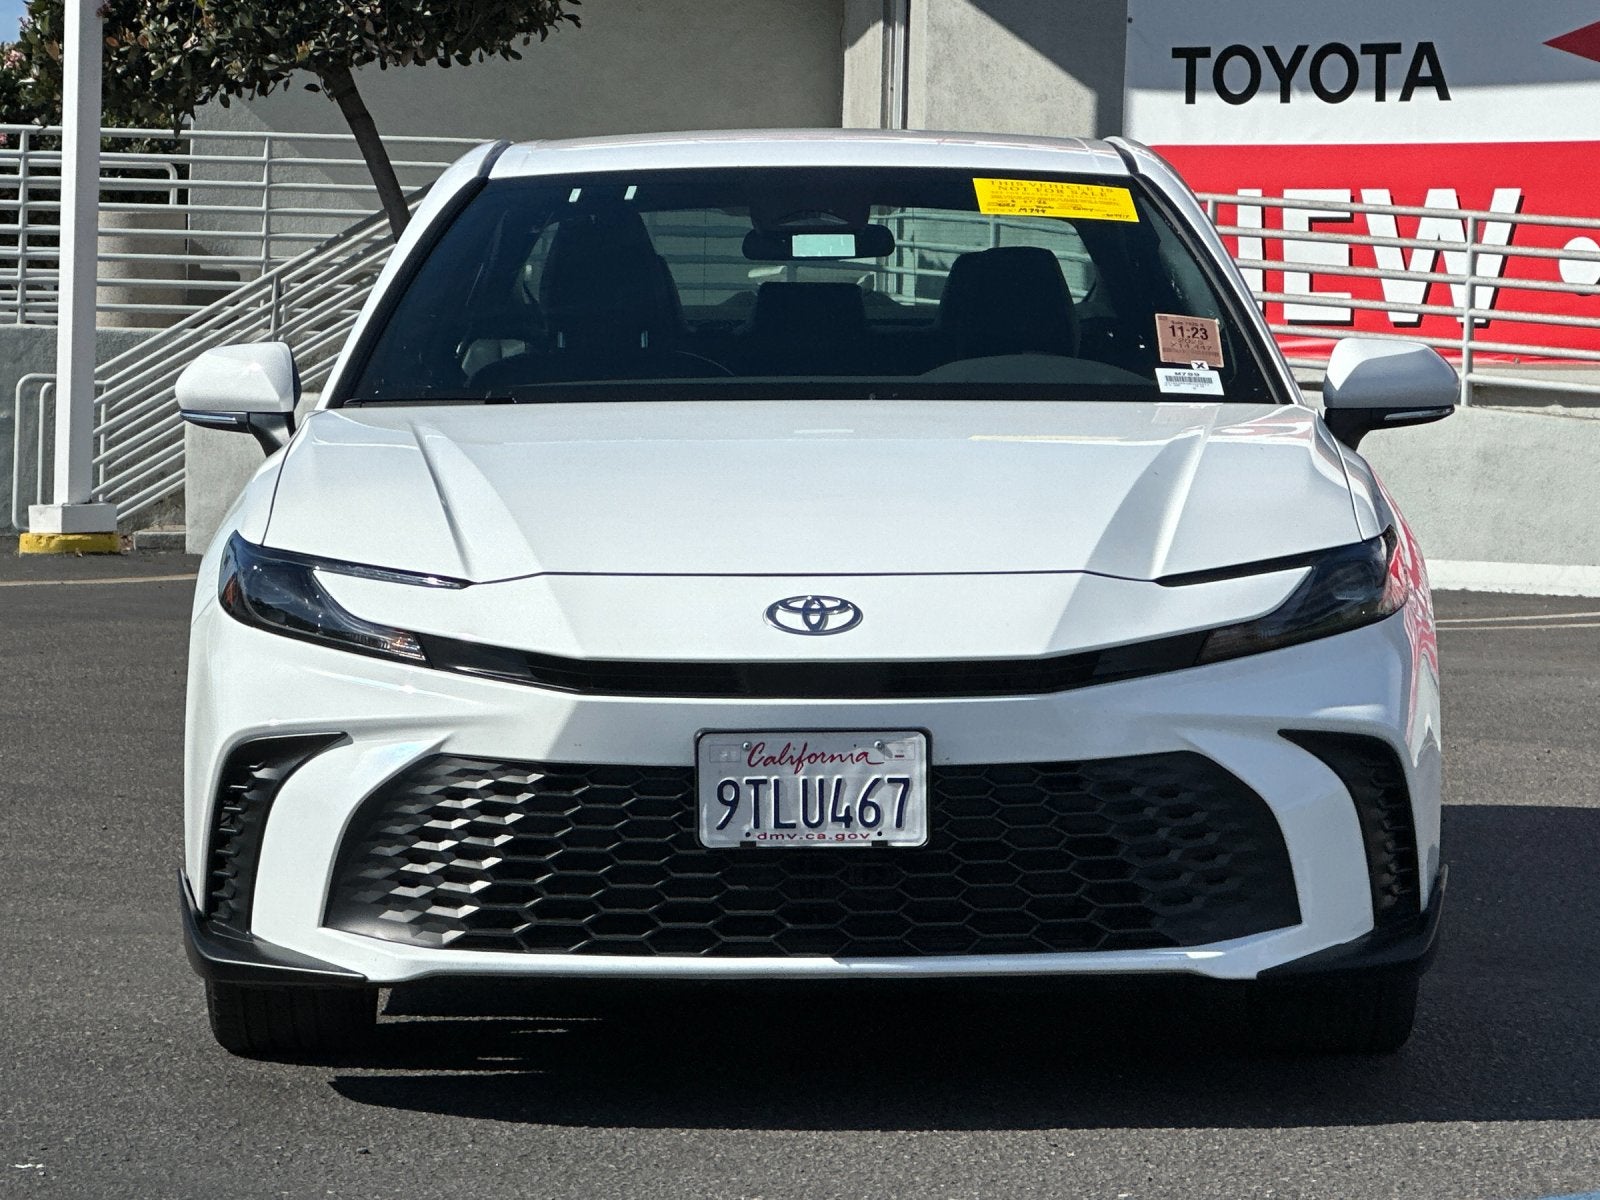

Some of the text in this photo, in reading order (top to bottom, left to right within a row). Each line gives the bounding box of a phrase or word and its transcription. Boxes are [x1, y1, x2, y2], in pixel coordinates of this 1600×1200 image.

[1171, 41, 1451, 106] TOYOTA
[1027, 182, 1092, 191] VEHICLE
[747, 742, 885, 774] California
[716, 777, 911, 831] 9TLU467
[756, 831, 871, 841] dmv.ca.gov
